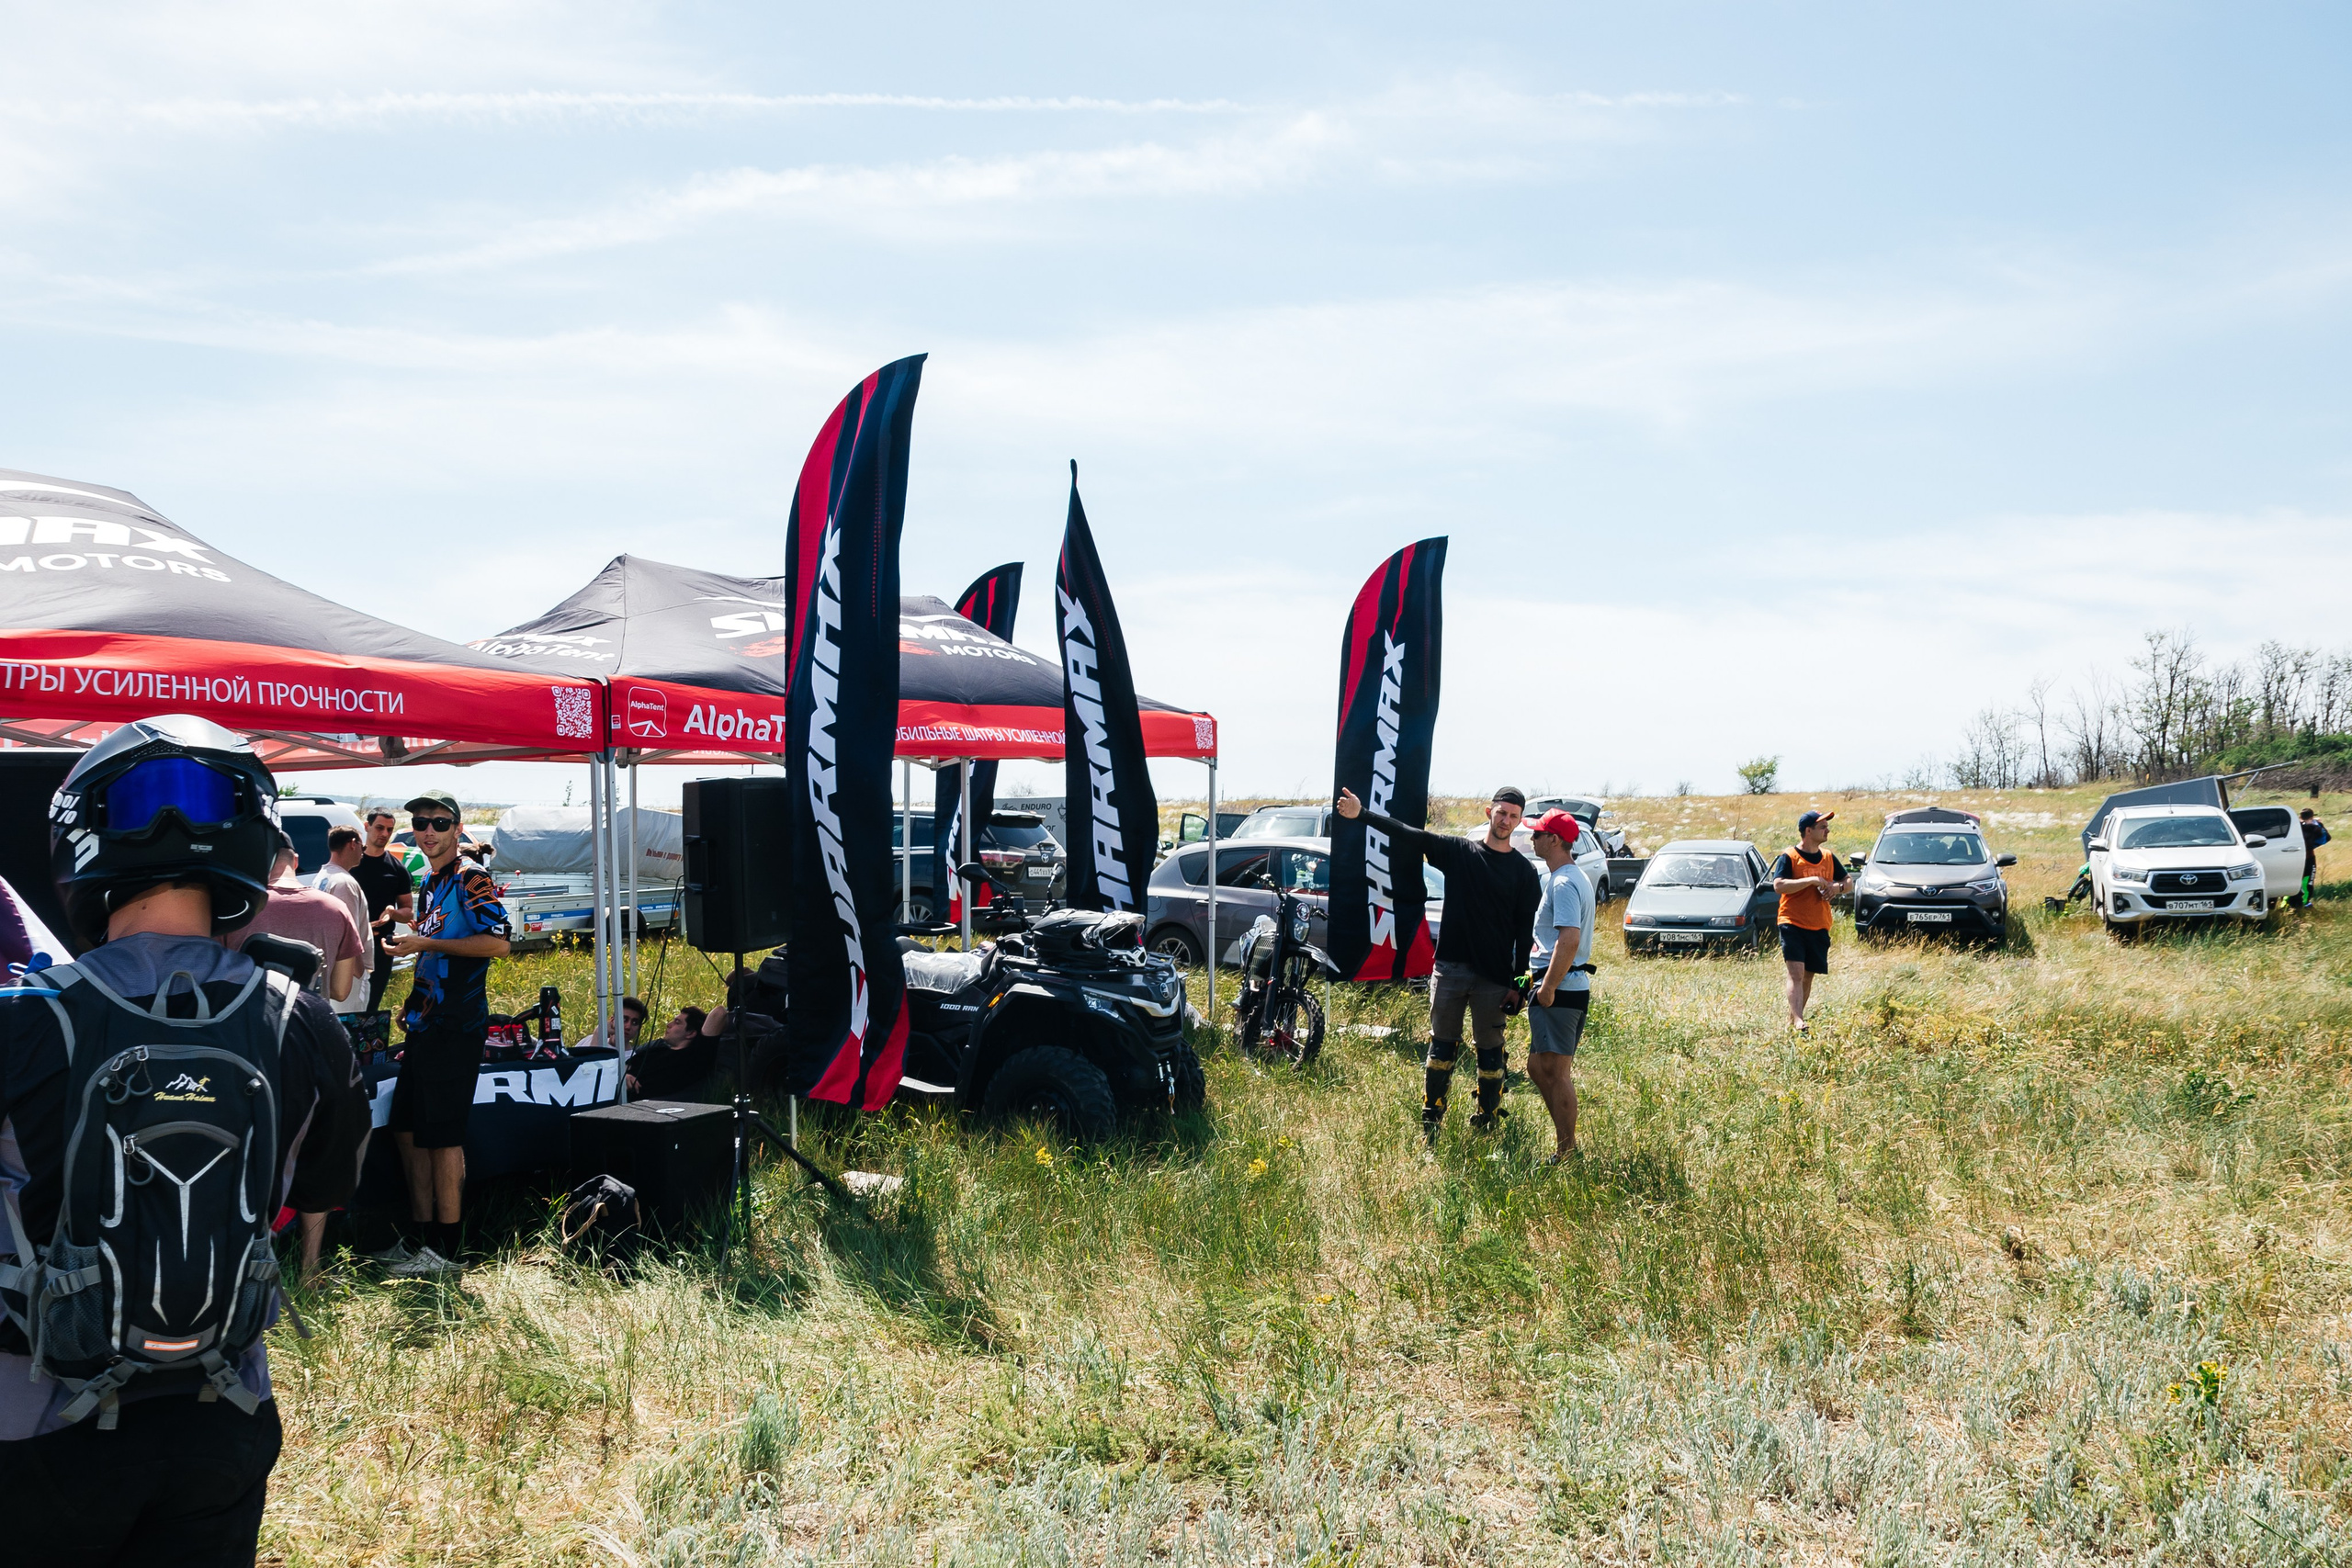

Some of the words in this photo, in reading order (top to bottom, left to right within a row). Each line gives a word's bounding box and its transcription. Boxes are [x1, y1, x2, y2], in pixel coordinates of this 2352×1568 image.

[74, 668, 252, 704] УСИЛЕННОЙ
[257, 681, 404, 715] ПРОЧНОСТИ
[630, 700, 665, 712] AlphaTent
[960, 728, 1004, 742] ШАТРЫ
[1002, 728, 1066, 745] УСИЛЕННОЙ
[1366, 629, 1406, 951] SHARMAX
[1020, 803, 1052, 811] ENDURO
